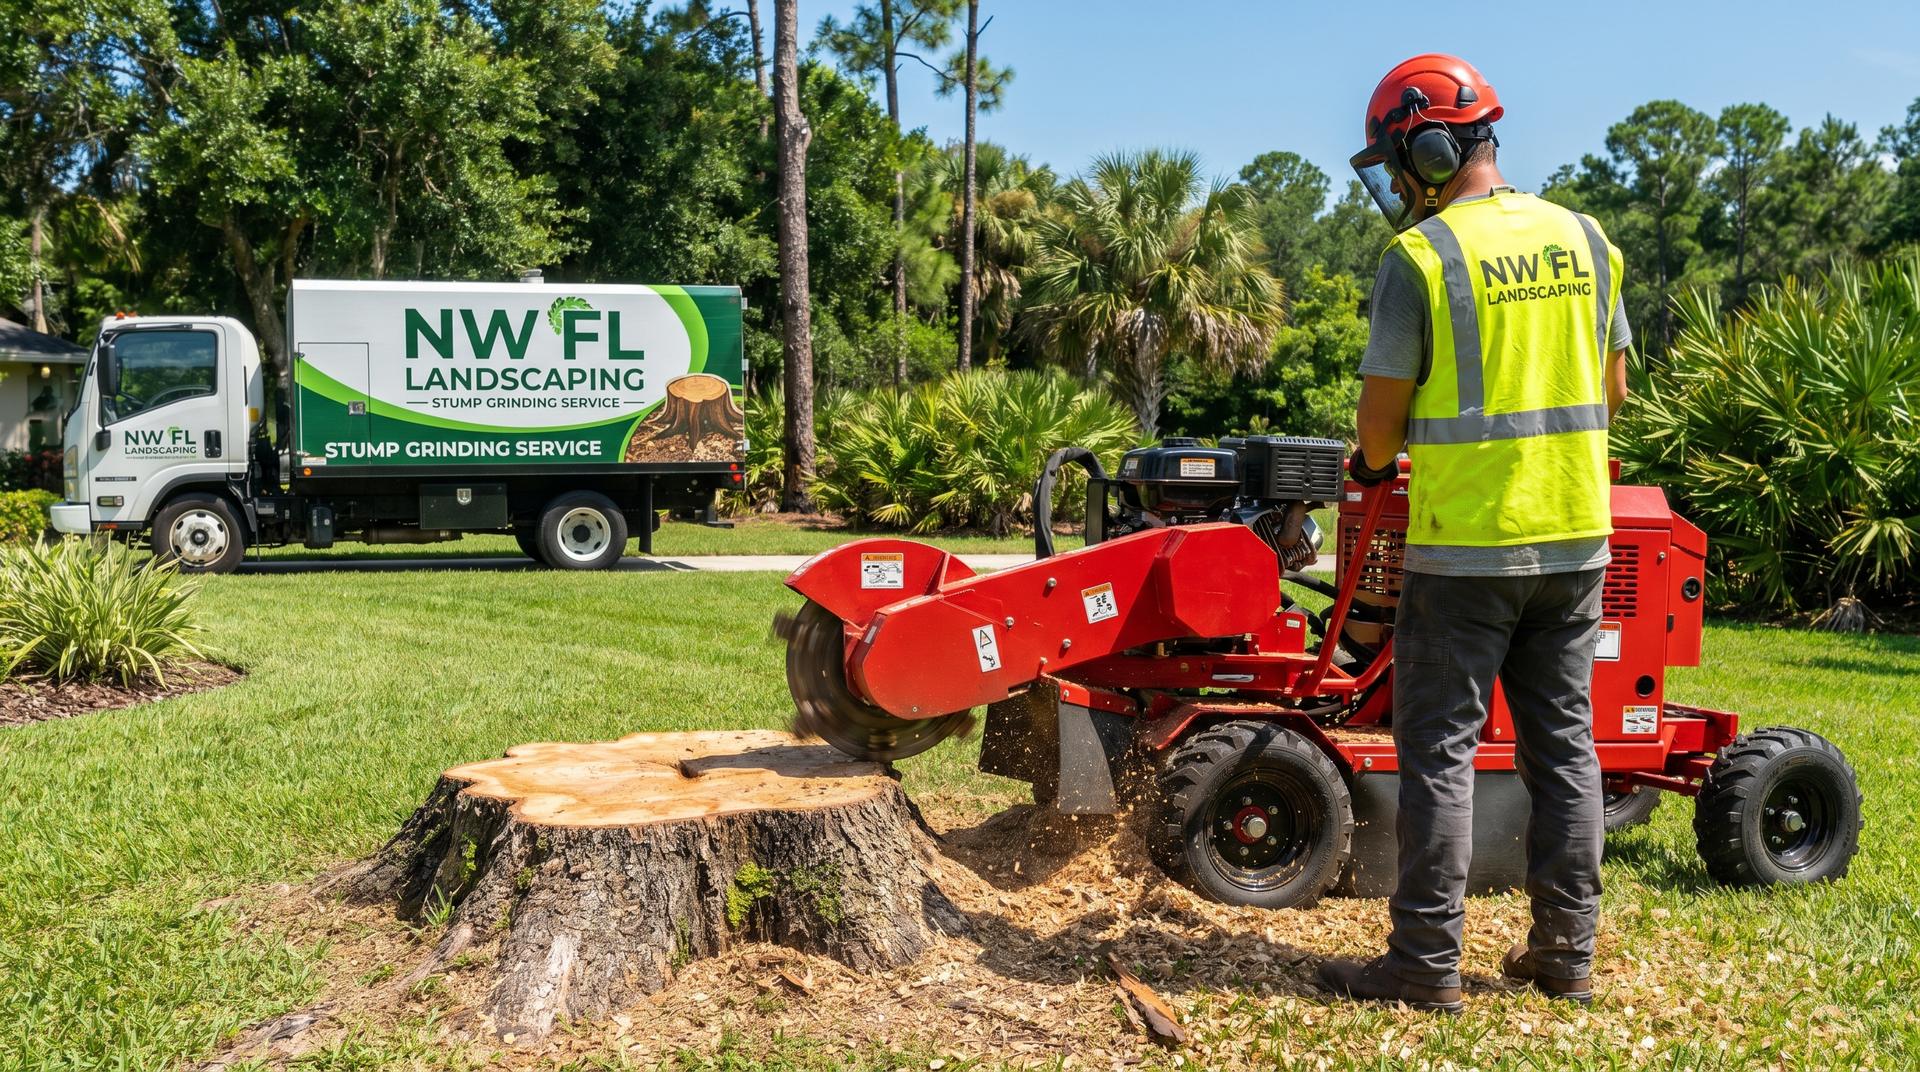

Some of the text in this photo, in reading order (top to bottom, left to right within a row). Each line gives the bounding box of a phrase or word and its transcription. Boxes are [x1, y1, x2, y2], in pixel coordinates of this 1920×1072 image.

[1480, 250, 1590, 288] NW FL
[1487, 282, 1592, 306] LANDSCAPING
[405, 308, 645, 361] NW FL
[405, 367, 645, 392] LANDSCAPING
[432, 397, 620, 409] STUMP GRINDING SERVICE
[124, 430, 197, 445] NW FL
[124, 446, 197, 455] LANDSCAPING
[325, 440, 602, 459] STUMP GRINDING SERVICE
